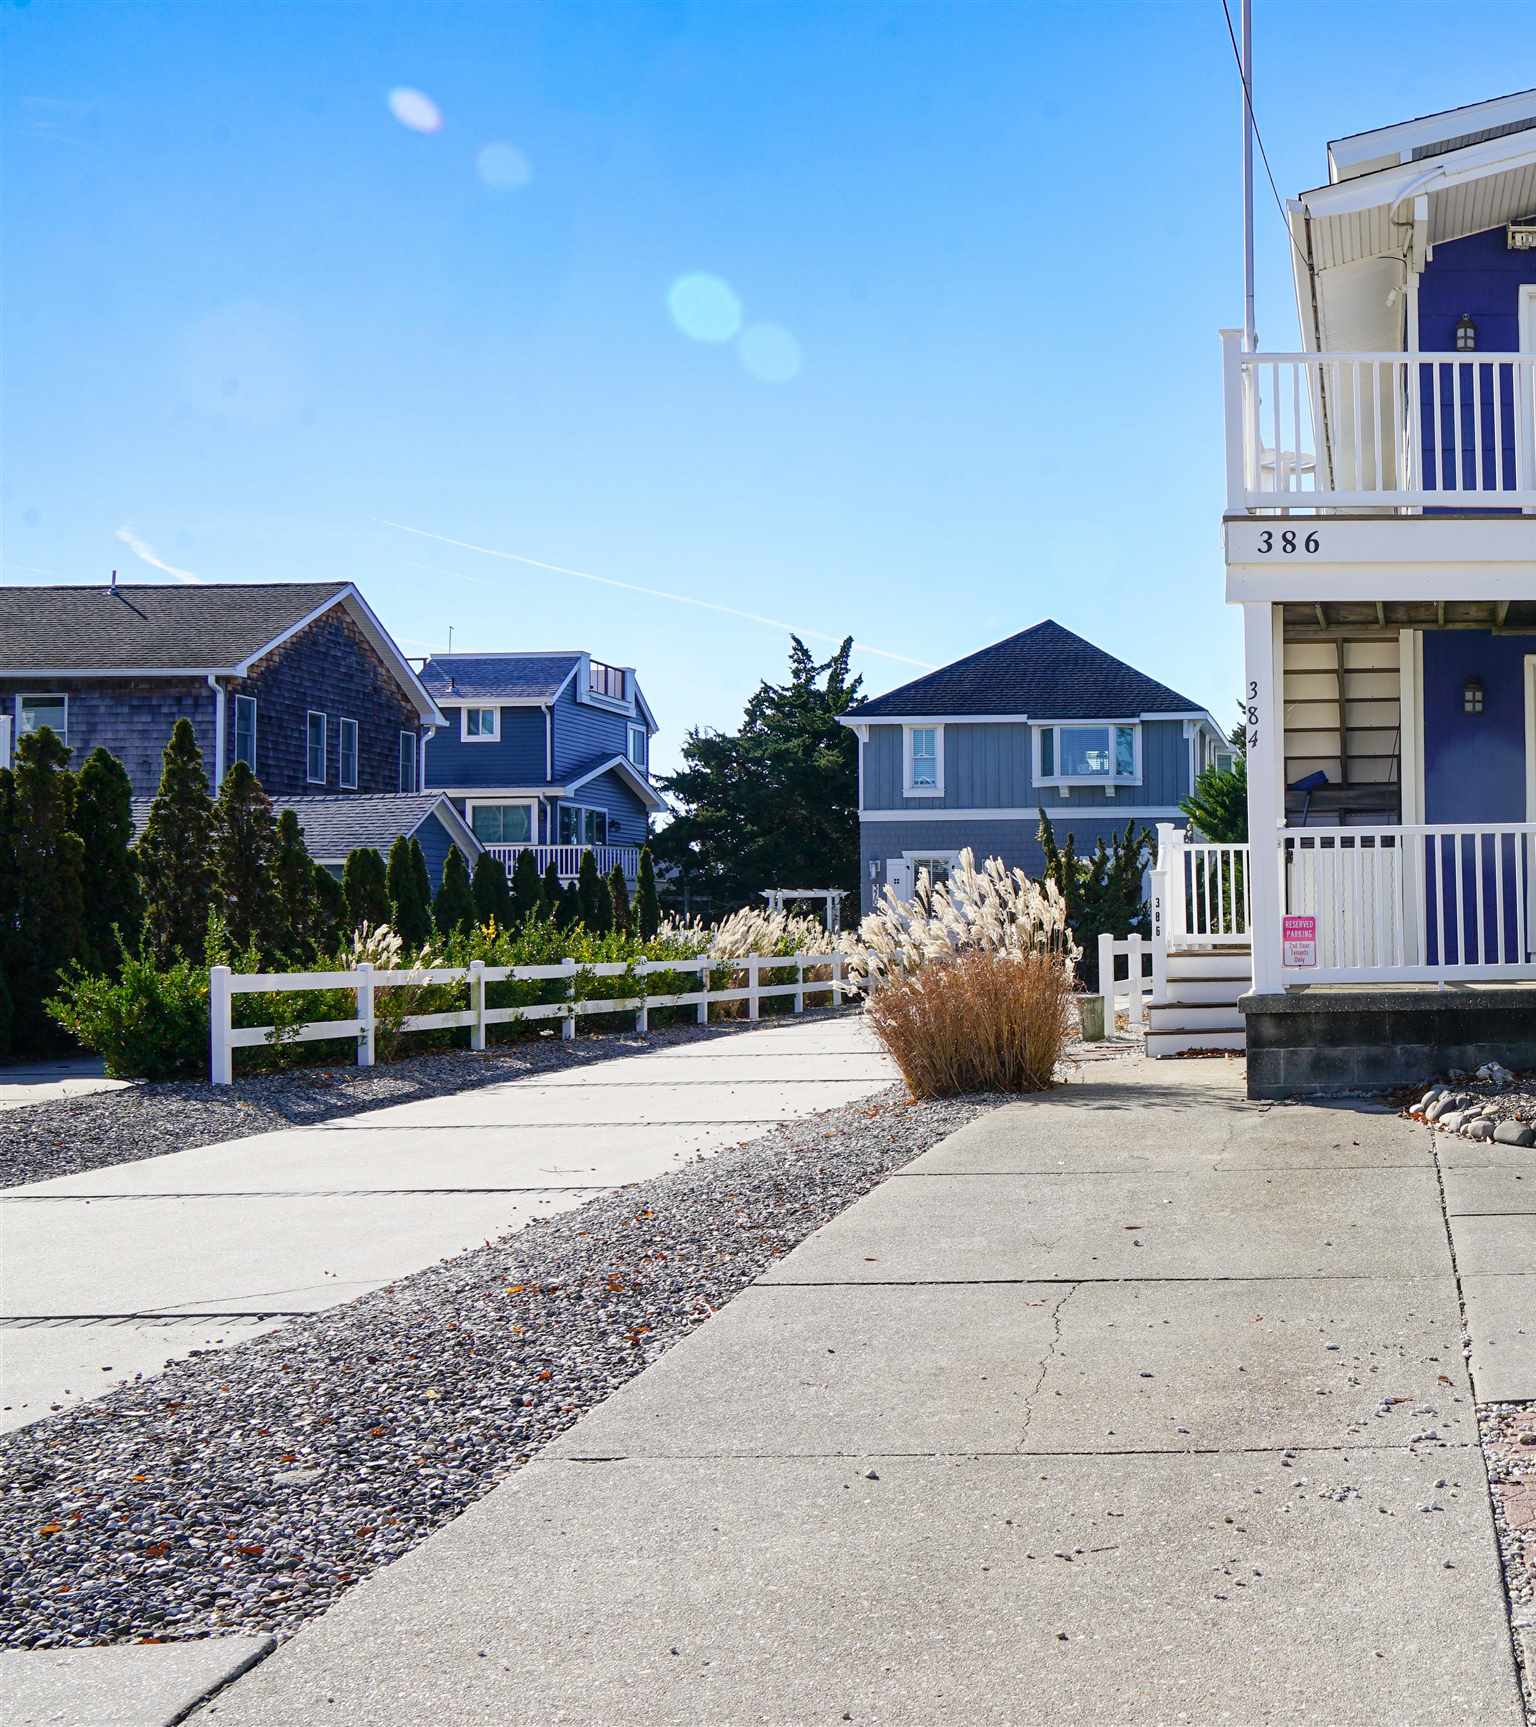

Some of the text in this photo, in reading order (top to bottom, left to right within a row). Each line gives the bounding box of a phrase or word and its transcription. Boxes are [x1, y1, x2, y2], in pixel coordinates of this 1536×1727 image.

[1257, 530, 1320, 554] 386
[1247, 681, 1259, 749] 384
[1285, 920, 1313, 928] RESERVED
[1286, 929, 1313, 938] PARKING
